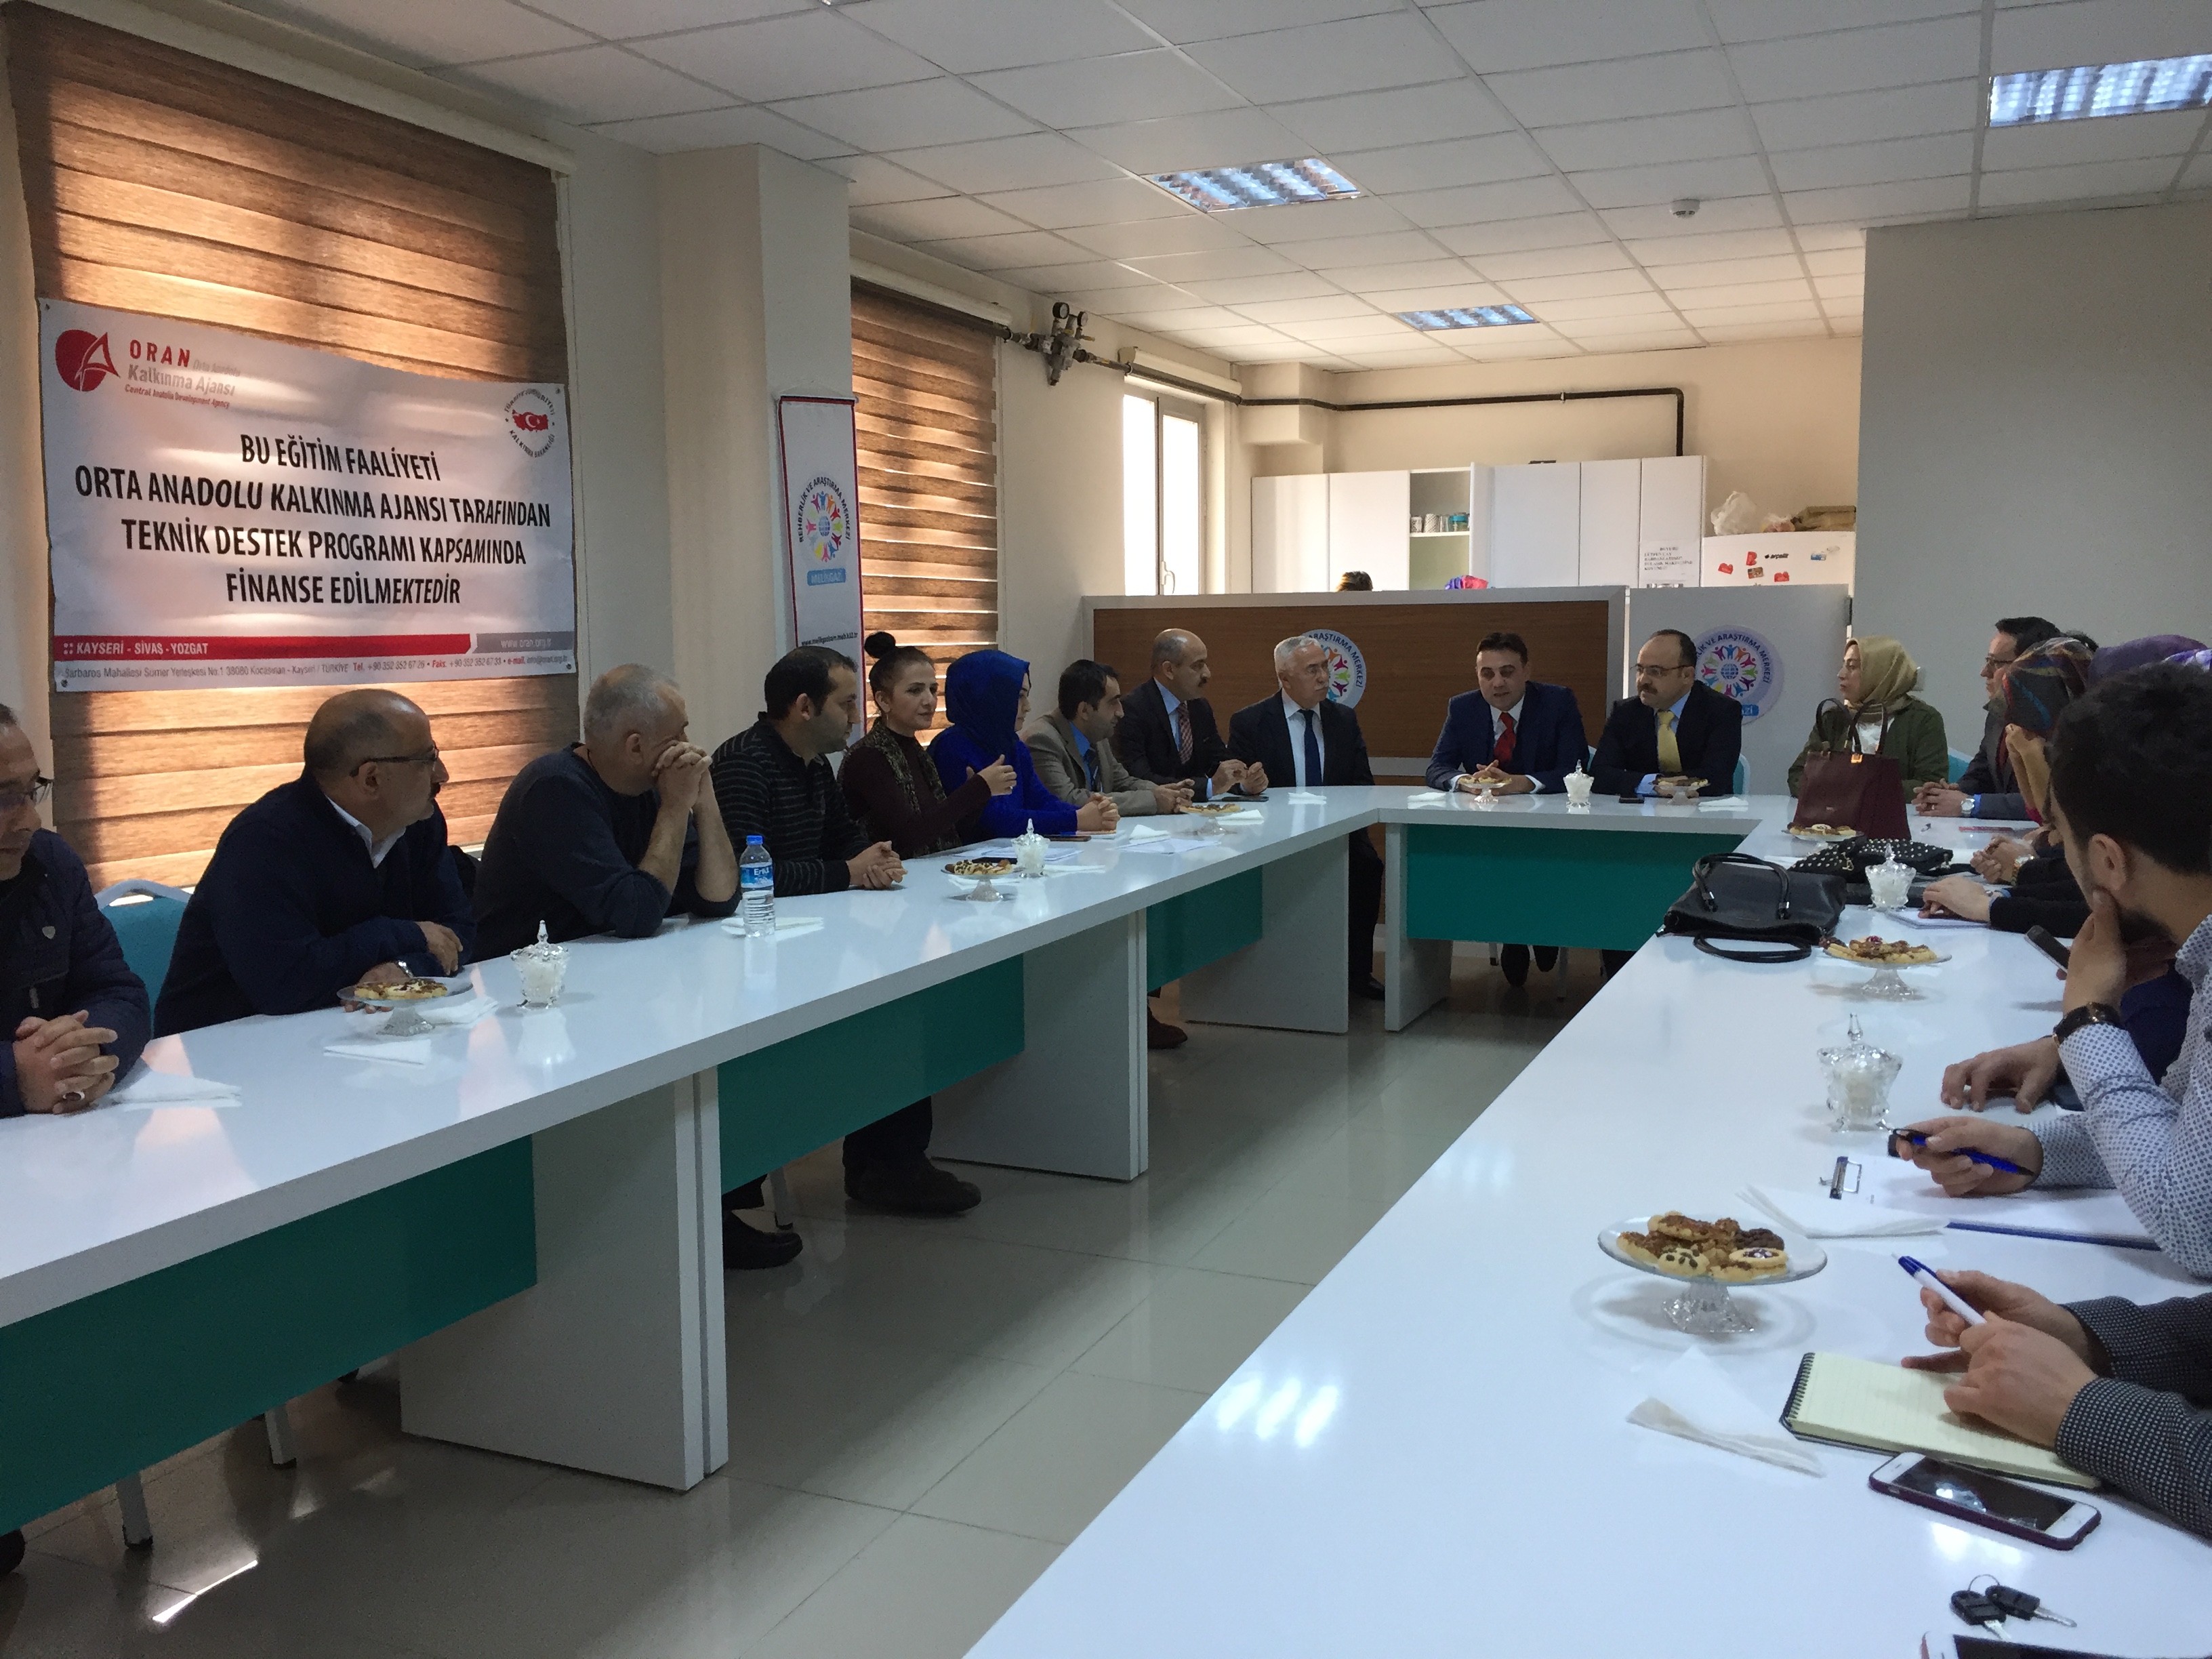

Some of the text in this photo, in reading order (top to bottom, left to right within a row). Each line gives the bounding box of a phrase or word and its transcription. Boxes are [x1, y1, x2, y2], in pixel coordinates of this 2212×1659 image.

[129, 339, 190, 367] ORAN
[125, 384, 151, 396] Central
[127, 364, 236, 396] Kalkınma Ajansı
[241, 434, 441, 481] BU EĞİTİM FAALİYETİ
[75, 465, 551, 527] ORTA ANADOLU KALKINMA AJANSI TARAFINDAN
[797, 491, 808, 543] REHBERLİK
[805, 482, 814, 493] VE
[813, 476, 842, 500] ARAŞTIRMA
[121, 516, 527, 565] TEKNİK DESTEK PROGRAMI KAPSAMINDA
[226, 567, 461, 604] FİNANSE EDİLMEKTEDİR
[76, 640, 124, 655] KAYSERİ
[134, 640, 164, 655] SİVAS
[171, 642, 209, 655] YOZGAT
[1705, 637, 1716, 646] VE
[1717, 633, 1761, 652] ARAŞTIRMA
